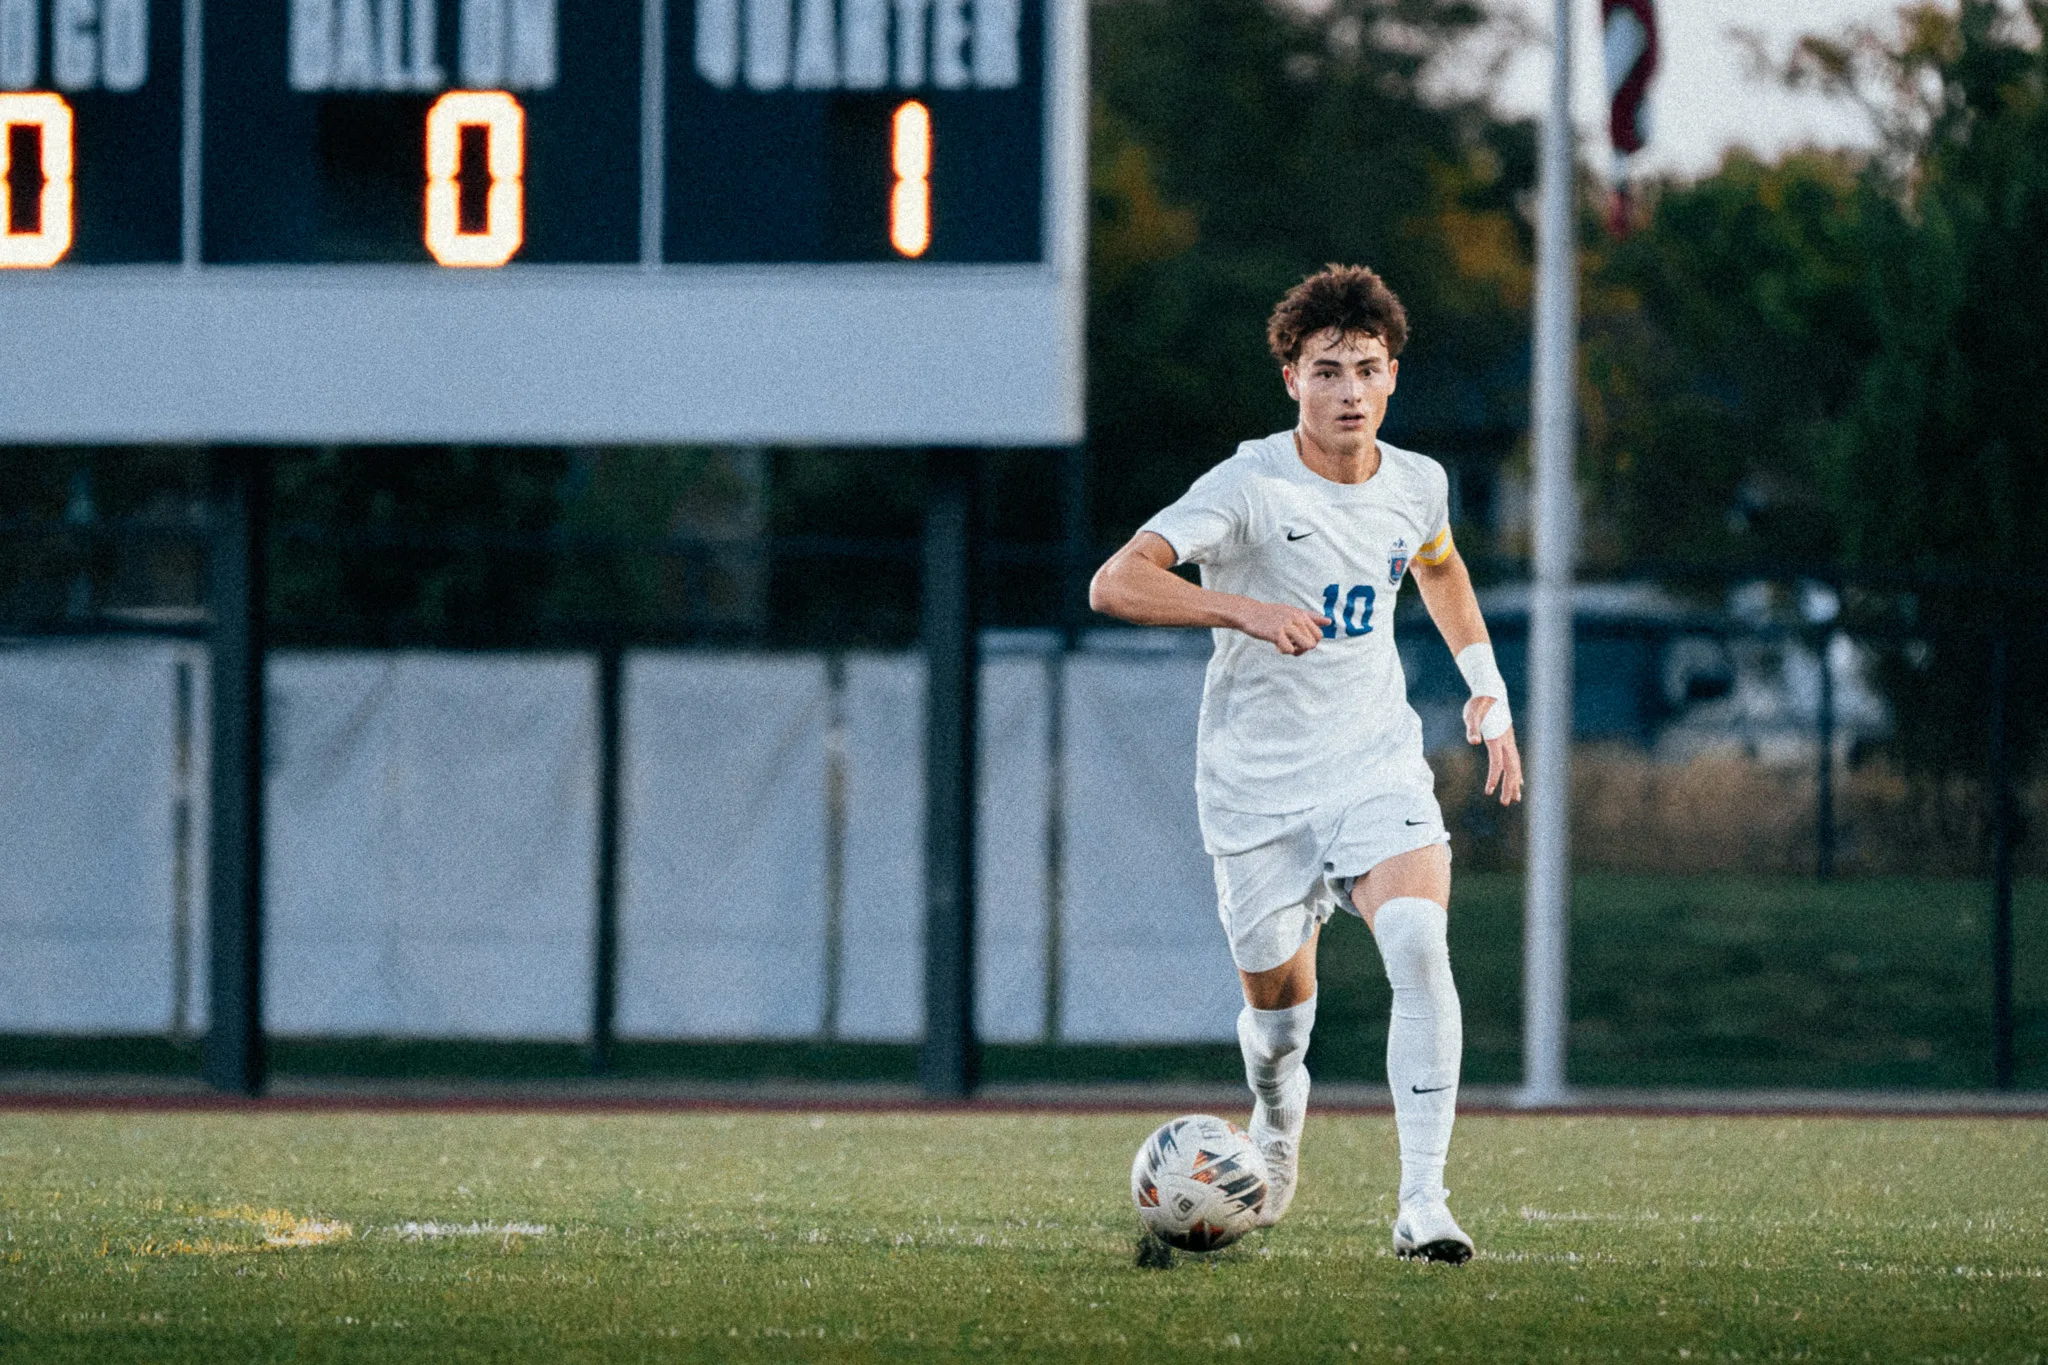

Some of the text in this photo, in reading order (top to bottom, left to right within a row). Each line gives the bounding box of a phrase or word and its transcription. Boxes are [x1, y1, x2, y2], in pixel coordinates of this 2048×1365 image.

[290, 0, 555, 89] BALL ON
[696, 0, 1020, 89] QUARTER
[0, 91, 73, 267] 0
[426, 91, 523, 267] 0
[892, 101, 931, 258] 1
[1322, 584, 1375, 638] 10
